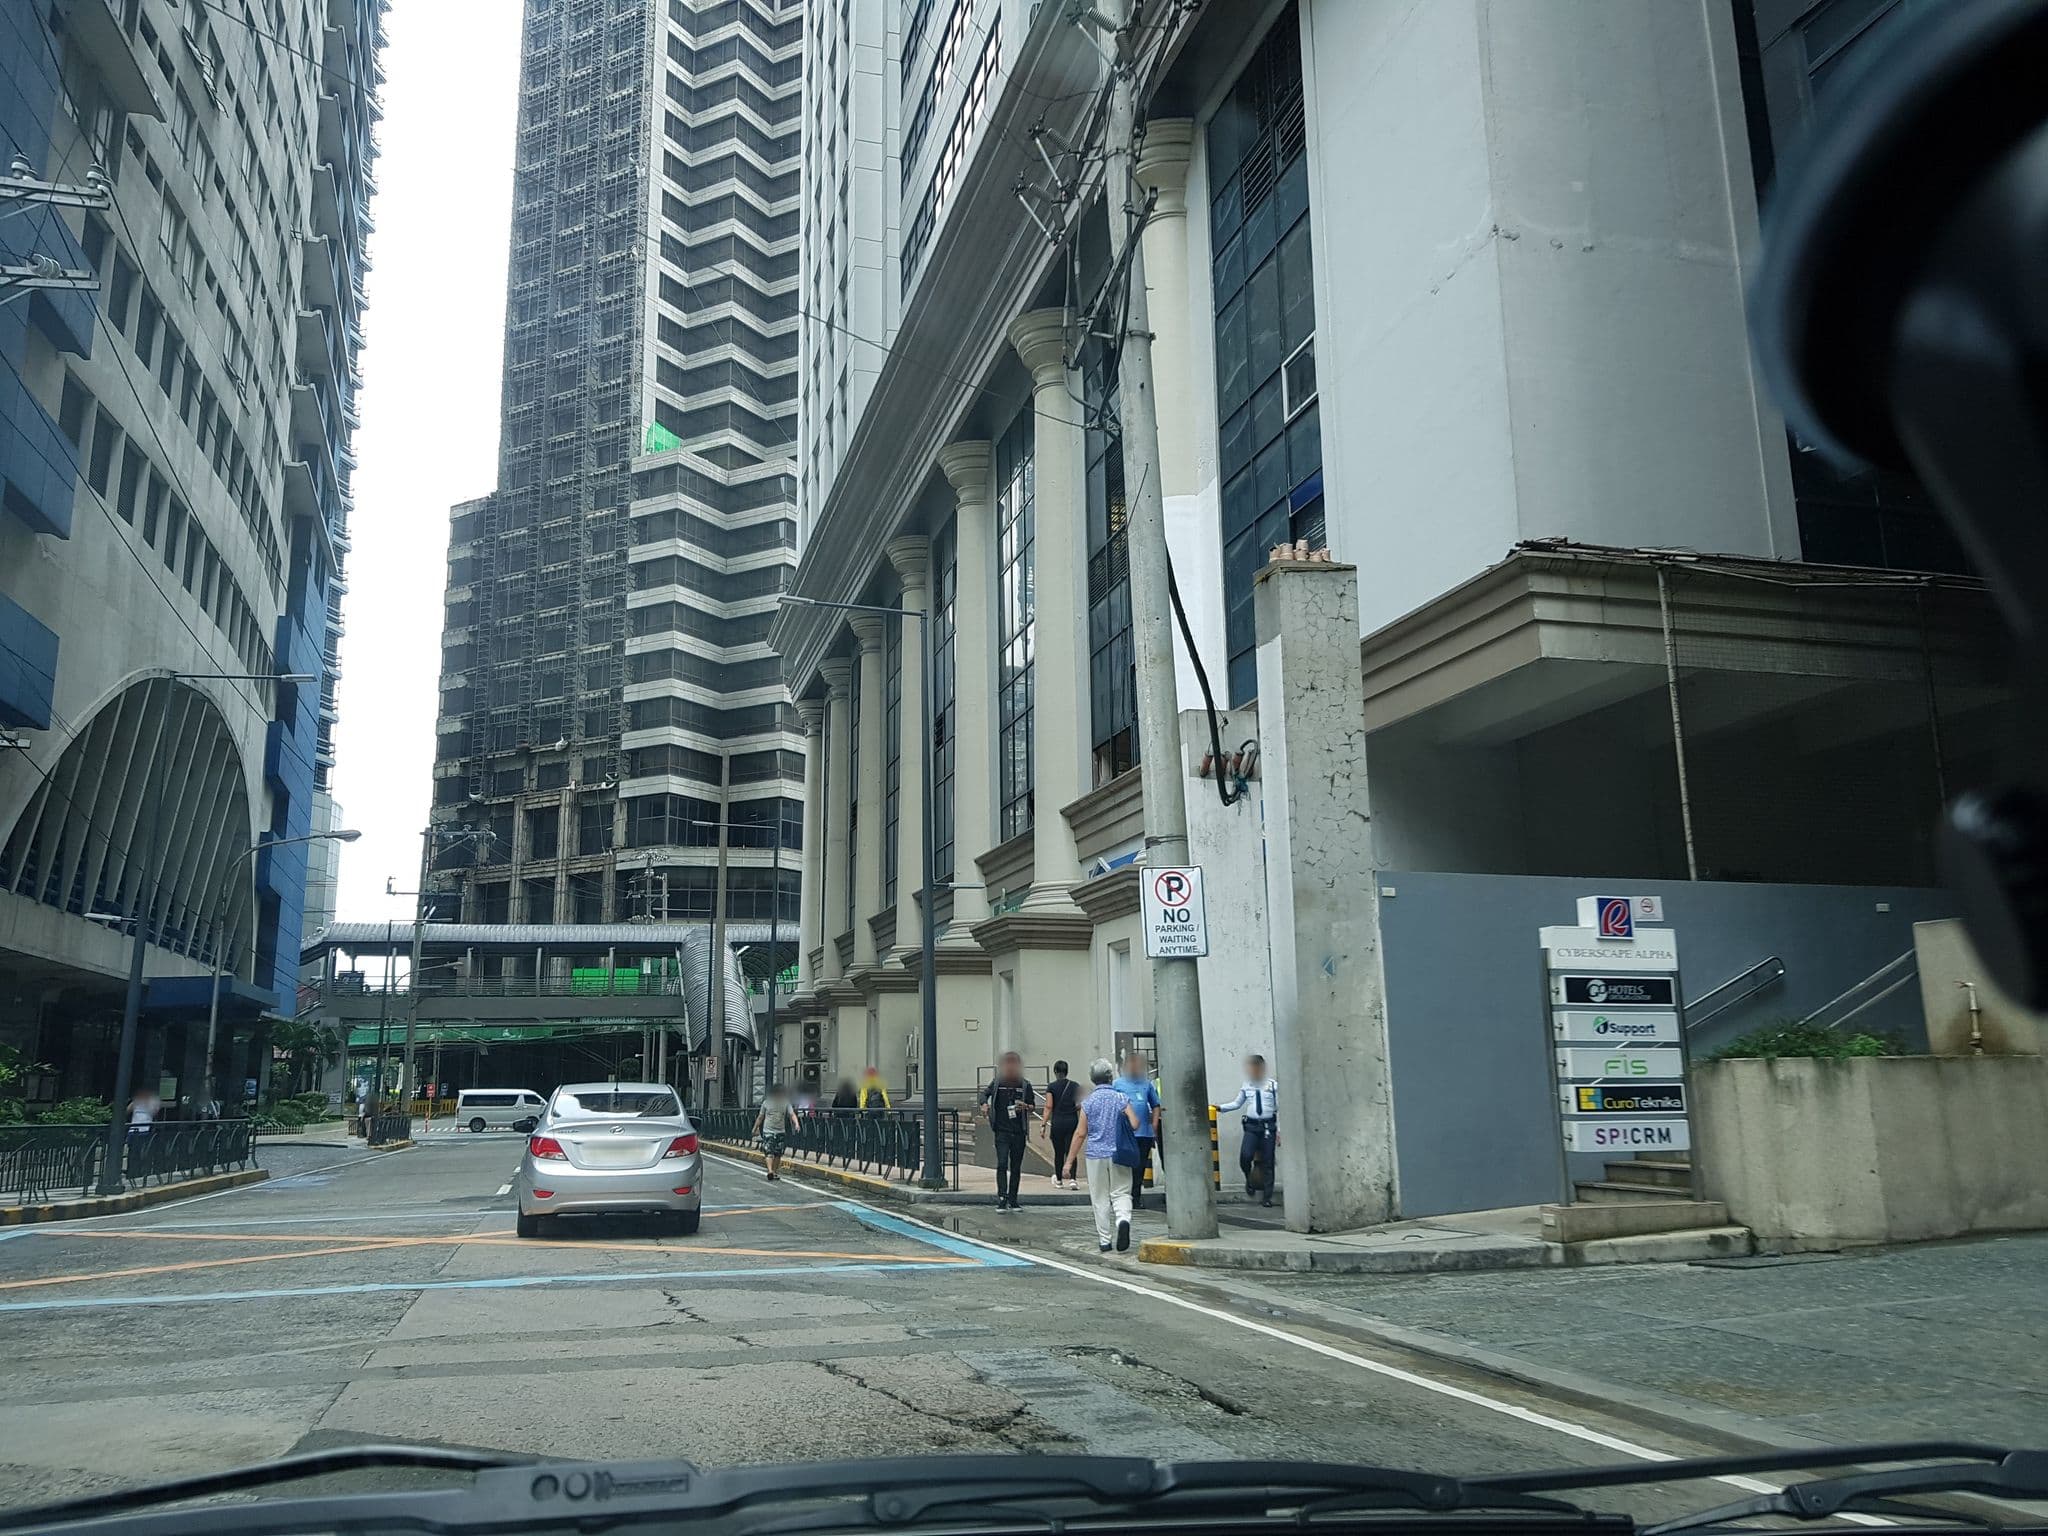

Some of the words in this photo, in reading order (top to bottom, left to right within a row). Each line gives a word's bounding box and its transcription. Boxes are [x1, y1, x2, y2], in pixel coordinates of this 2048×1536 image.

[1166, 876, 1183, 901] P
[1163, 908, 1190, 923] NO
[1155, 924, 1194, 933] PARKING
[1159, 934, 1197, 943] WAITING
[1159, 945, 1198, 954] ANYTIME
[1557, 948, 1632, 958] CYBERSCAPE
[1636, 950, 1673, 959] ALPHA
[1608, 985, 1644, 995] HOTELS
[1604, 1097, 1681, 1109] CuroTeknika
